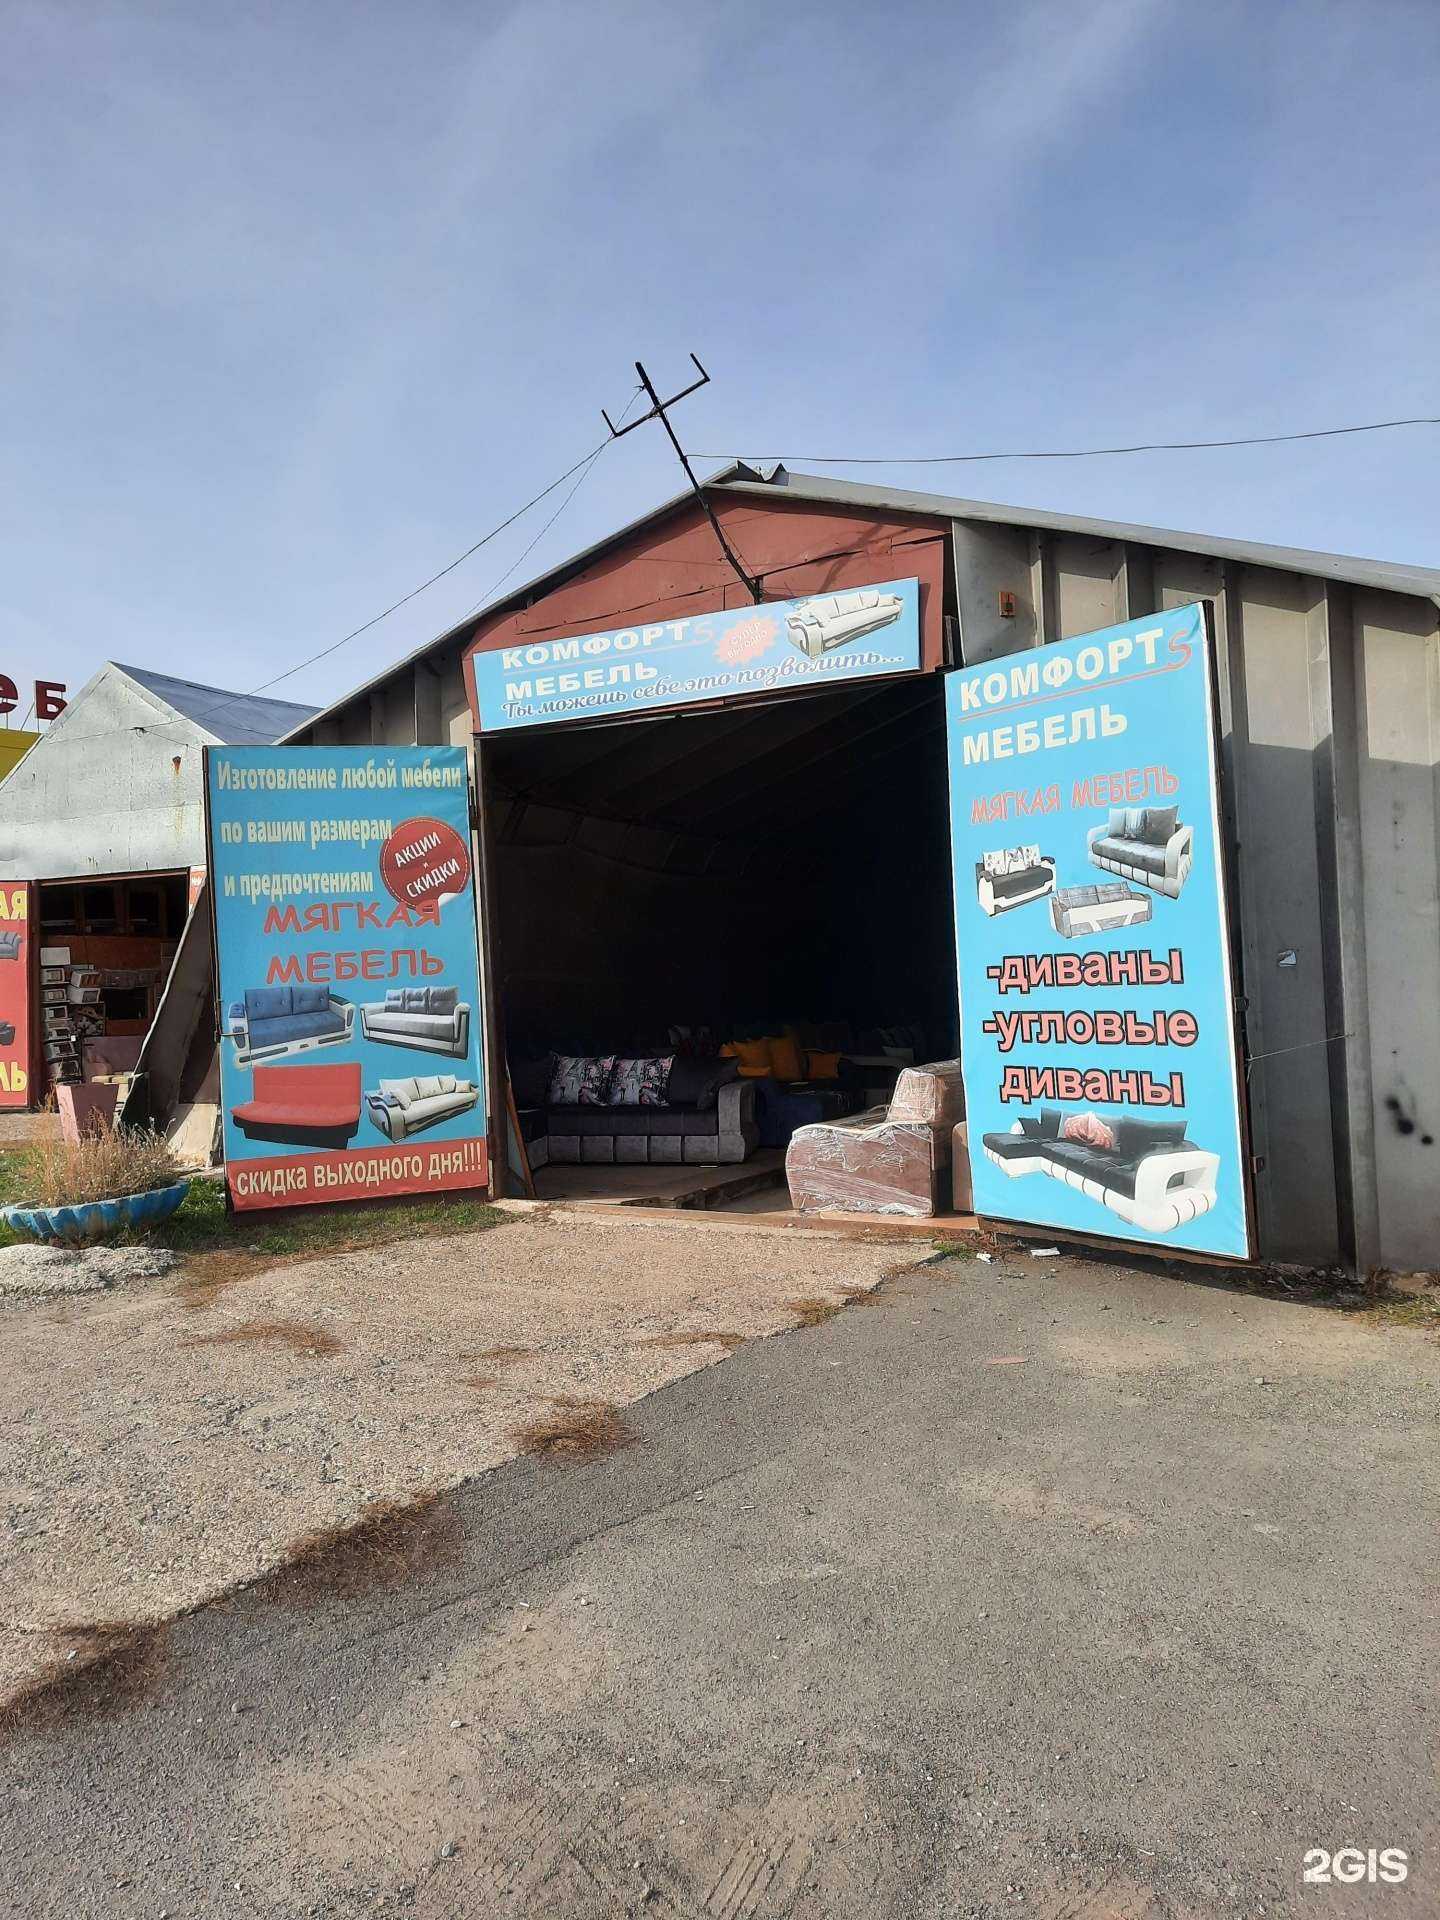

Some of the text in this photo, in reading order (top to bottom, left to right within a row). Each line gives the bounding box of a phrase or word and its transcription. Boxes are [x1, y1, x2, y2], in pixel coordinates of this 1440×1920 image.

[503, 701, 533, 719] Ты
[538, 690, 628, 715] можешь
[632, 673, 681, 699] себе
[684, 675, 732, 691] это
[505, 662, 659, 701] МЕБЕЛЬ
[962, 704, 1129, 766] МЕБЕЛЬ
[217, 759, 462, 791] Изготовление любой мебели
[970, 764, 1180, 826] МЯГКАЯ МЕБЕЛЬ
[220, 817, 392, 850] по вашим размерам
[394, 831, 441, 868] АКЦИИ
[223, 875, 236, 897] и
[239, 871, 374, 905] предпочтениям
[406, 858, 460, 898] СКИДКИ
[263, 901, 440, 935] МЯГКАЯ
[266, 949, 445, 985] МЕБЕЛЬ
[1000, 1065, 1186, 1107] диваны
